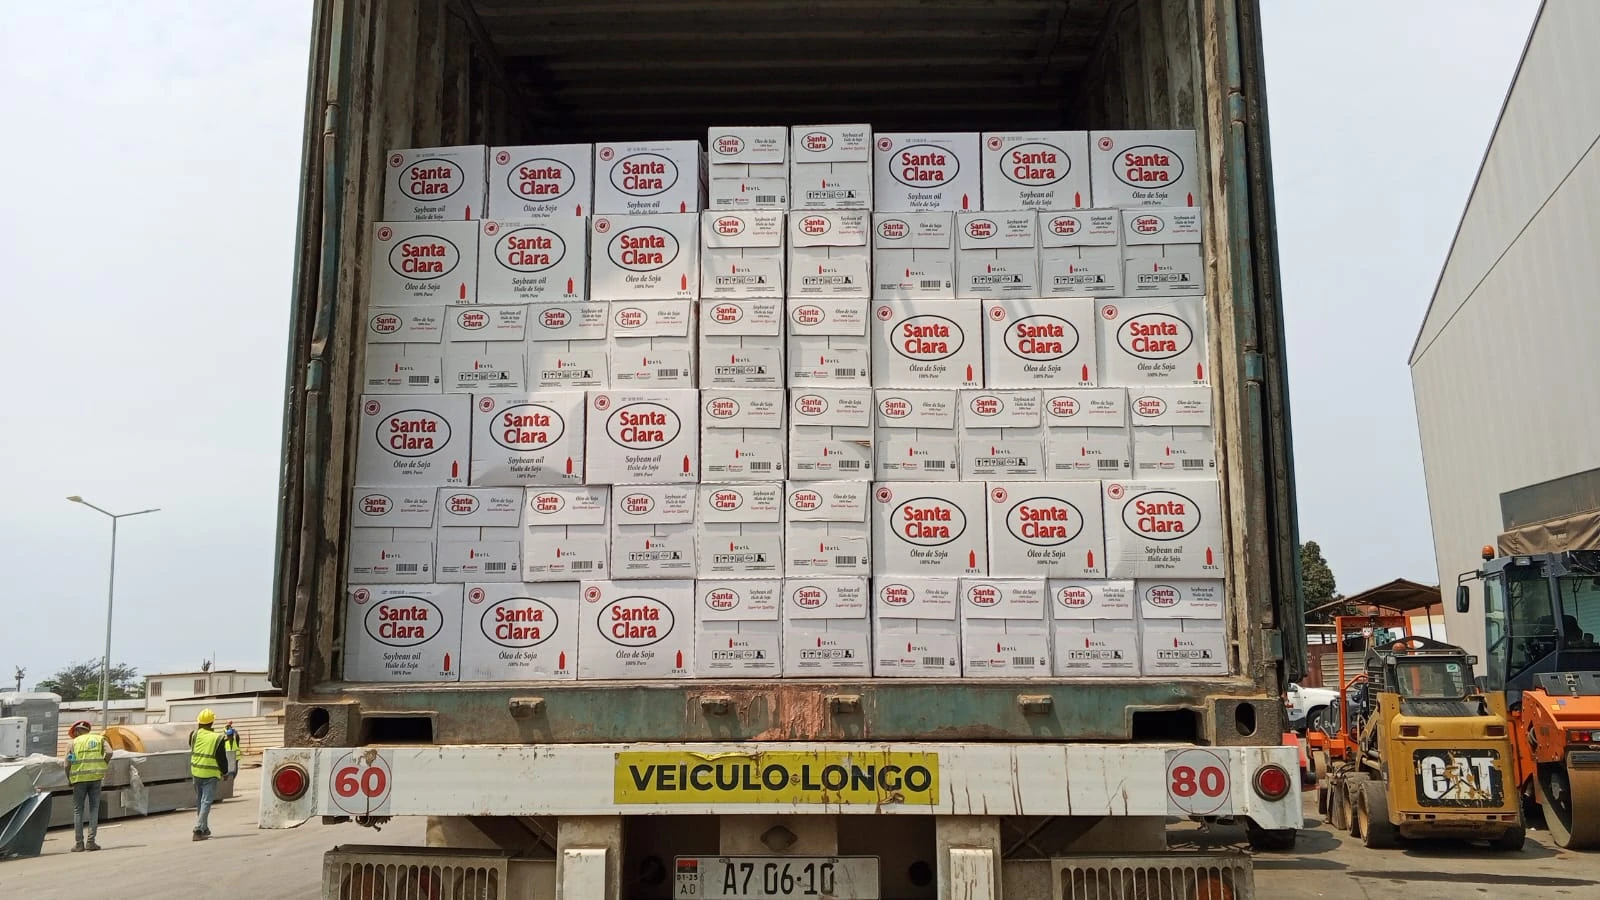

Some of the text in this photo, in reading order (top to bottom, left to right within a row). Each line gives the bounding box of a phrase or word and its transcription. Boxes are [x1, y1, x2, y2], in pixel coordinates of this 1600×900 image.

[719, 145, 738, 153] Clara
[807, 142, 827, 150] Clara
[902, 153, 945, 167] Santa
[1013, 151, 1056, 164] Santa
[1125, 154, 1169, 166] Santa
[411, 167, 452, 180] Santa
[520, 167, 561, 180] Santa
[623, 162, 665, 174] Santa
[903, 167, 944, 181] Clara
[1014, 165, 1056, 179] Clara
[1127, 167, 1168, 181] Clara
[411, 180, 448, 195] Clara
[520, 181, 559, 195] Clara
[623, 175, 662, 189] Clara
[883, 223, 903, 231] Santa
[970, 229, 991, 237] Clara
[508, 236, 552, 250] Santa
[621, 235, 665, 249] Santa
[402, 244, 445, 257] Santa
[622, 249, 663, 264] Clara
[402, 258, 443, 272] Clara
[508, 251, 549, 265] Clara
[799, 307, 820, 315] Santa
[376, 316, 397, 324] Santa
[799, 315, 818, 323] Clara
[904, 324, 949, 337] Santa
[1017, 324, 1064, 338] Santa
[1130, 322, 1178, 336] Santa
[905, 338, 948, 353] Clara
[1019, 338, 1062, 353] Clara
[1132, 337, 1176, 352] Clara
[886, 408, 905, 416] Clara
[976, 406, 997, 414] Clara
[1139, 407, 1160, 415] Clara
[389, 418, 436, 433] Santa
[504, 413, 550, 427] Santa
[620, 412, 666, 426] Santa
[390, 434, 433, 449] Clara
[504, 428, 547, 443] Clara
[621, 427, 664, 442] Clara
[365, 496, 386, 505] Santa
[715, 492, 736, 500] Santa
[364, 505, 385, 513] Clara
[904, 506, 951, 521] Santa
[1020, 506, 1068, 521] Santa
[1136, 501, 1185, 515] Santa
[905, 522, 950, 538] Clara
[1022, 522, 1067, 538] Clara
[1138, 516, 1184, 532] Clara
[799, 589, 820, 597] Santa
[886, 587, 908, 595] Santa
[973, 588, 995, 596] Santa
[1064, 589, 1085, 597] Santa
[800, 598, 820, 606] Clara
[886, 595, 906, 603] Clara
[1153, 596, 1173, 604] Clara
[379, 605, 428, 621] Santa
[496, 607, 544, 622] Santa
[612, 606, 659, 621] Santa
[379, 622, 424, 638] Clara
[496, 623, 540, 640] Clara
[612, 622, 657, 638] Clara
[335, 766, 386, 797] 60
[629, 764, 931, 792] VEICULO LONGO
[1172, 766, 1225, 797] 80
[1421, 756, 1495, 799] CAT
[723, 863, 754, 895] A7
